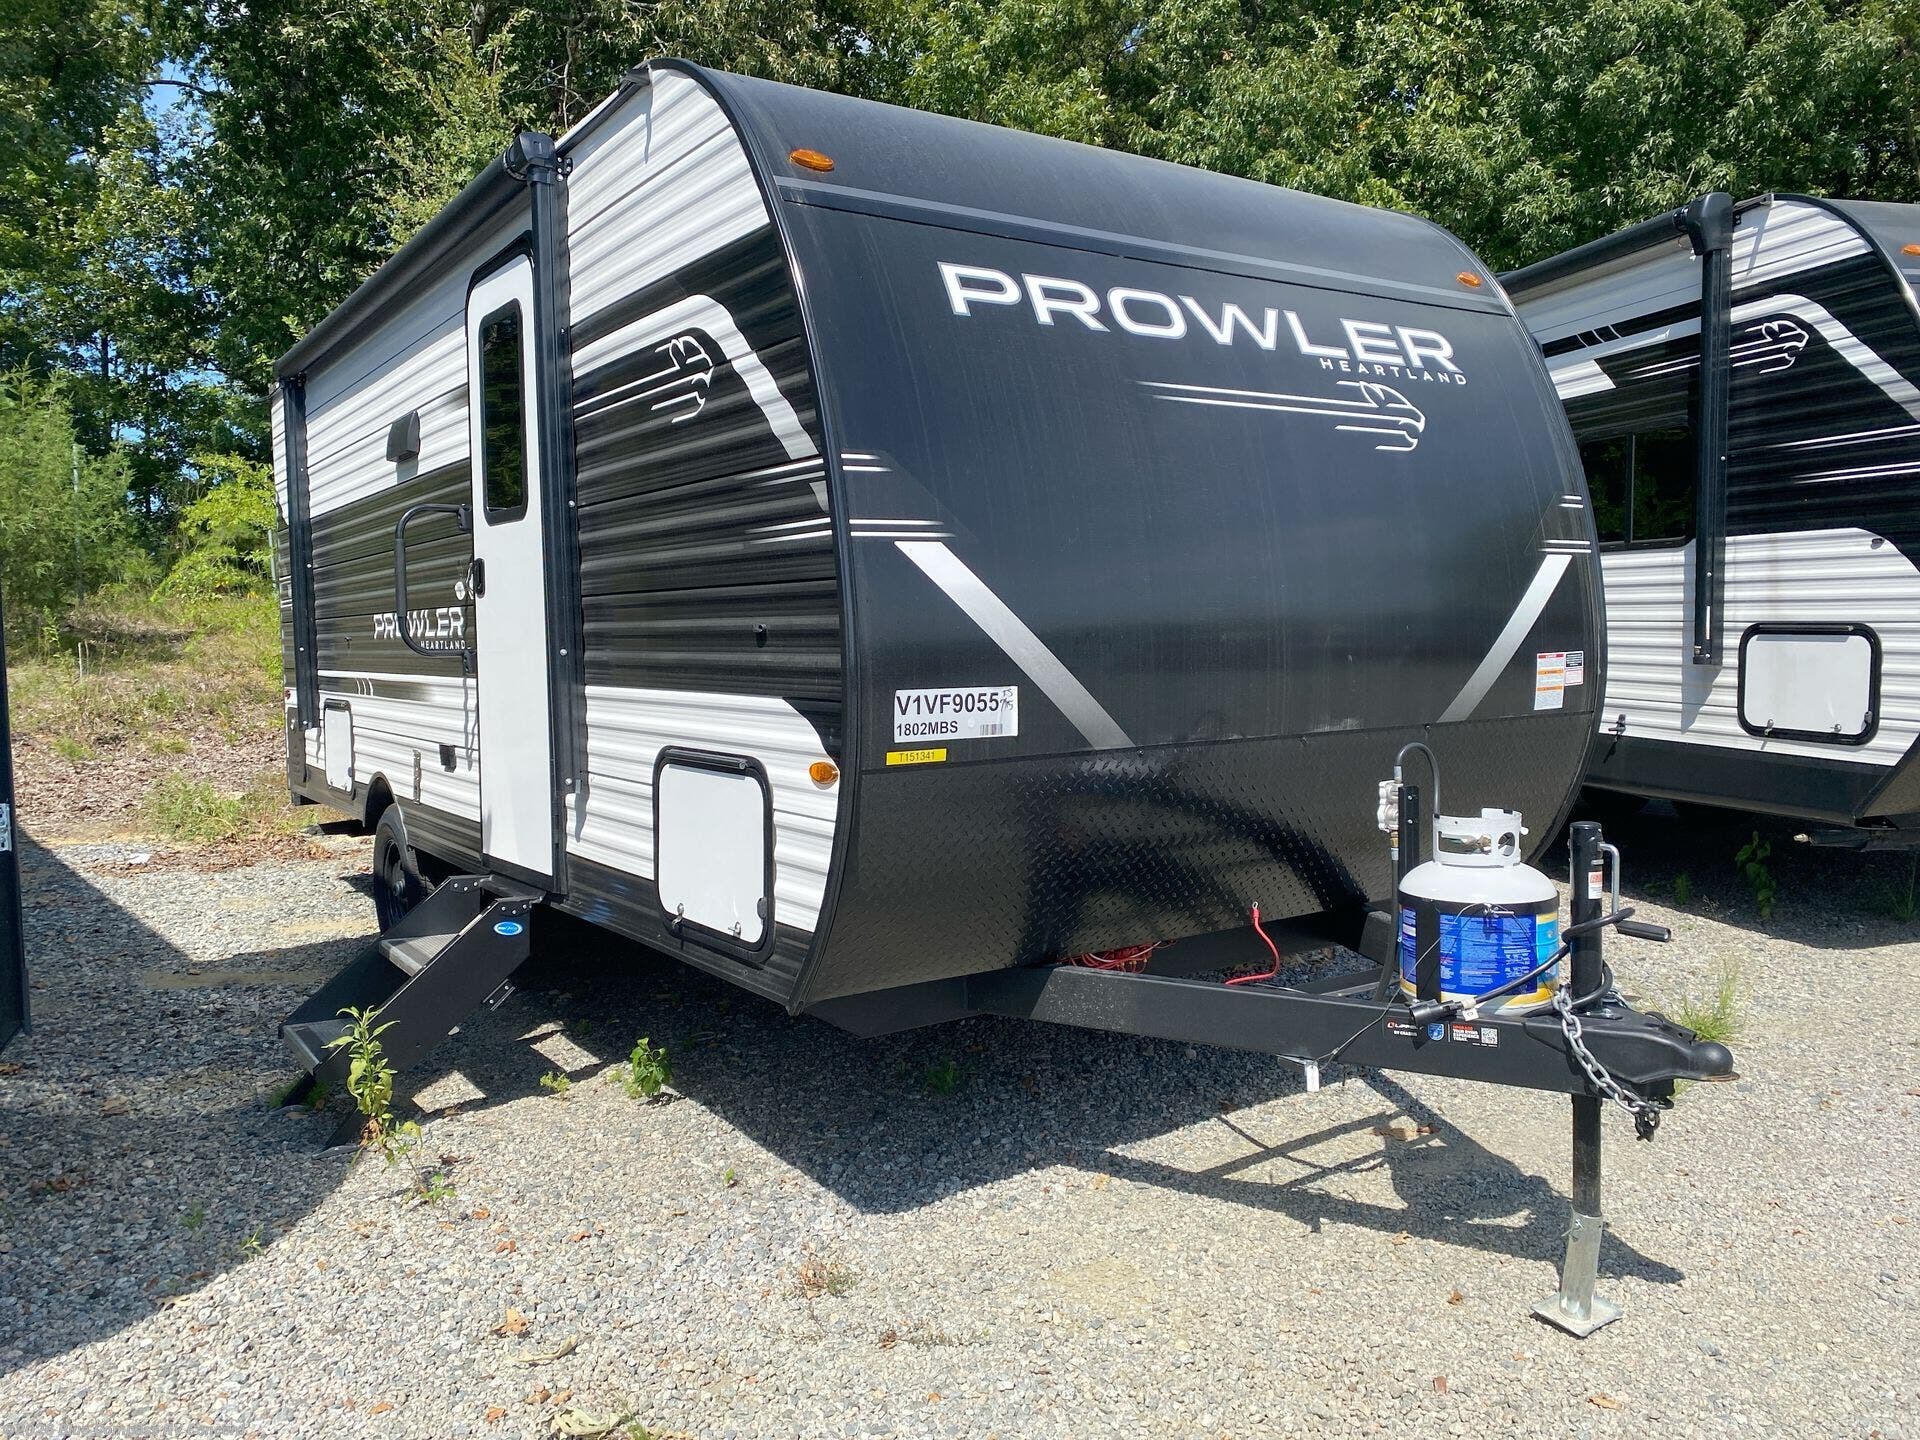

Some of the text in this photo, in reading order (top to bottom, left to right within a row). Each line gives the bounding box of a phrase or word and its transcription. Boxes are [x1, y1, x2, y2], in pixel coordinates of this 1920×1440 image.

[936, 261, 1463, 374] PROWLER
[1319, 356, 1467, 386] HEARTLAND
[420, 640, 466, 650] HEARTLAND
[896, 692, 999, 715] V1VF9055
[896, 720, 959, 737] 1802MBS
[899, 751, 936, 762] T151341
